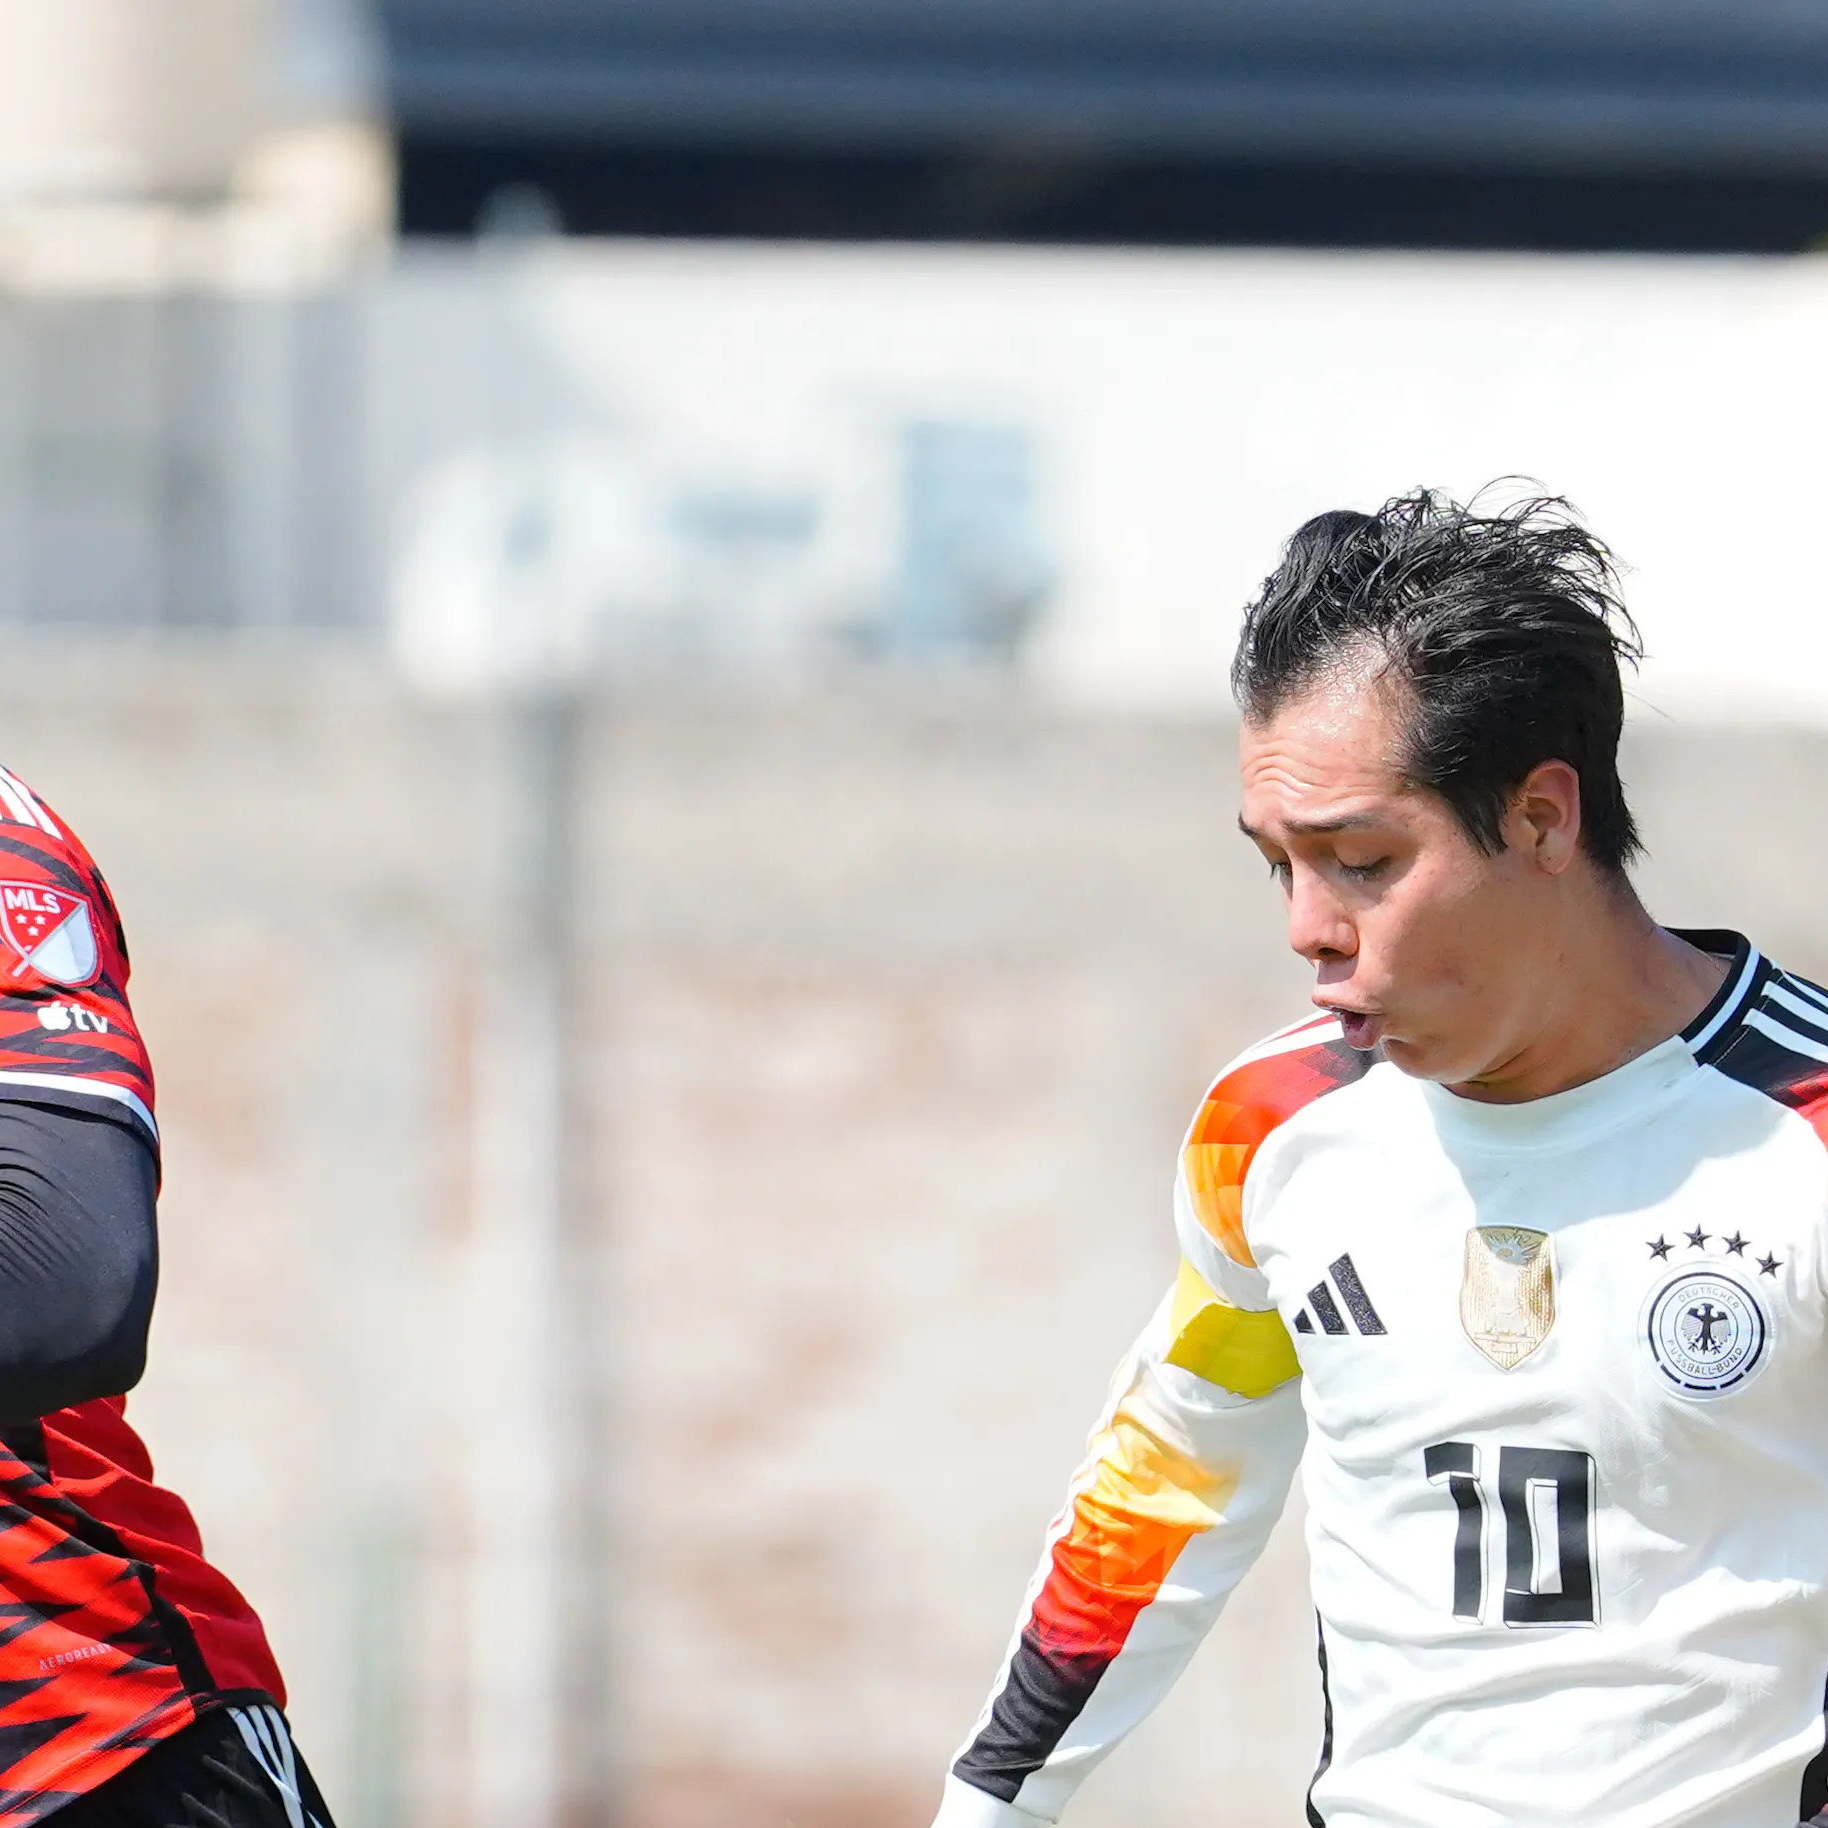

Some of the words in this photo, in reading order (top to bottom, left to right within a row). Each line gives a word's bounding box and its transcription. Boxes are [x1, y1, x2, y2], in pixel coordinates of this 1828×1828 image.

[4, 888, 62, 914] MLS
[70, 1002, 109, 1034] tv
[1677, 1286, 1740, 1310] DEUTSCHER
[1424, 1441, 1602, 1630] 10
